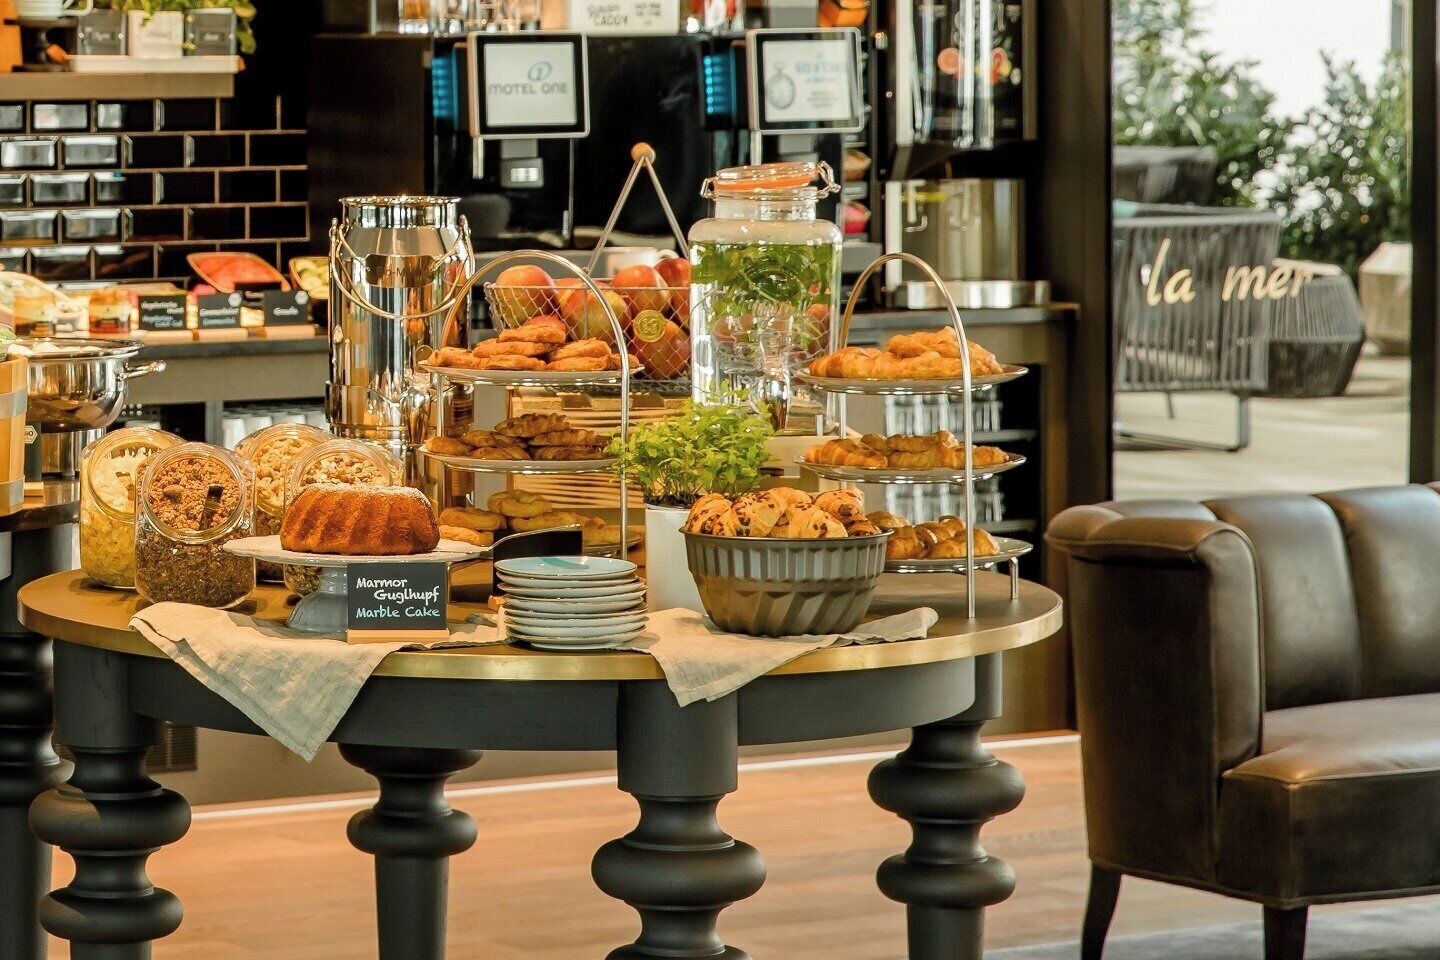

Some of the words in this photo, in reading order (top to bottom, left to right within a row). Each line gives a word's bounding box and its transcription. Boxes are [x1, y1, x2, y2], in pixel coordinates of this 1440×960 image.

[487, 83, 536, 95] MOTEL
[541, 81, 568, 94] ONE
[1146, 238, 1196, 307] la
[1221, 265, 1314, 302] mer
[356, 577, 408, 589] Marmor
[373, 585, 440, 606] Guglhupf
[355, 604, 401, 619] Marble
[405, 606, 441, 617] Cake
